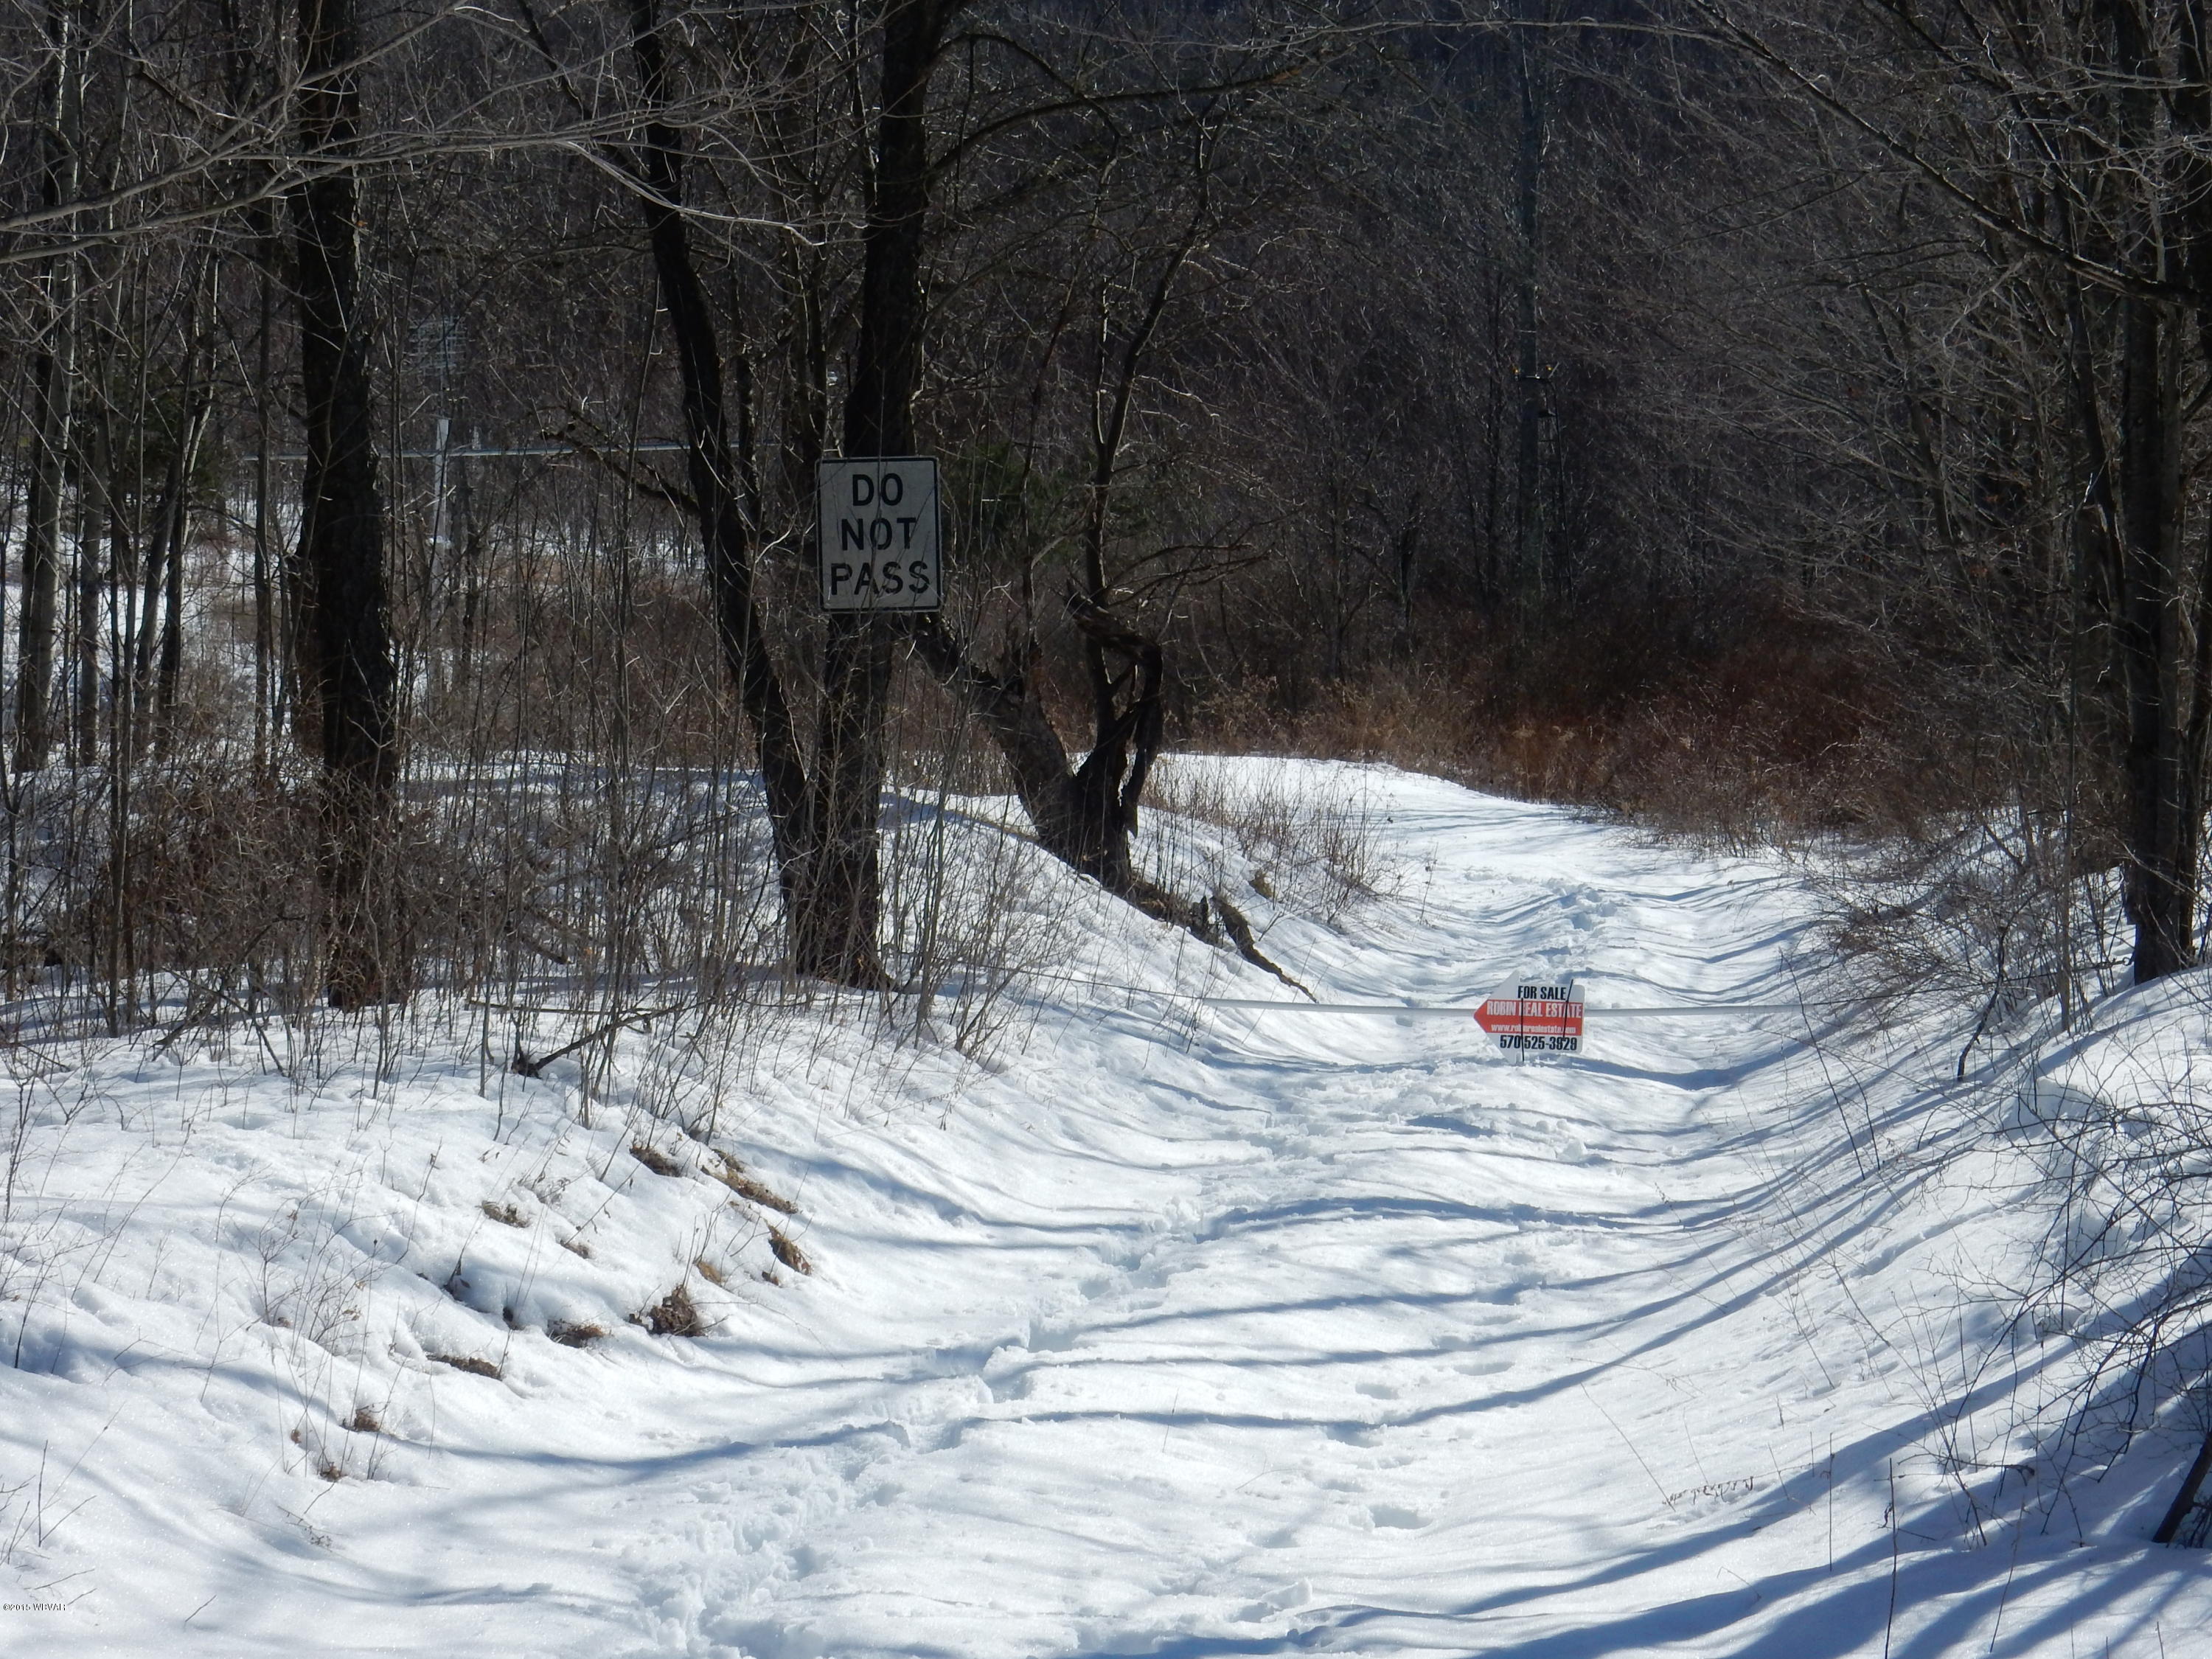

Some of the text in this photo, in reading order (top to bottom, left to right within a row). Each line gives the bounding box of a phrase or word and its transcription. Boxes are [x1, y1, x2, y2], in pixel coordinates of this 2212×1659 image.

[852, 473, 903, 507] DO
[841, 517, 917, 551] NOT
[831, 560, 930, 596] PASS
[1517, 985, 1566, 1001] FOR SALE
[1486, 1001, 1582, 1018] ROBIN REAL ESTATE
[1491, 1023, 1576, 1034] www.robnrealestate.com
